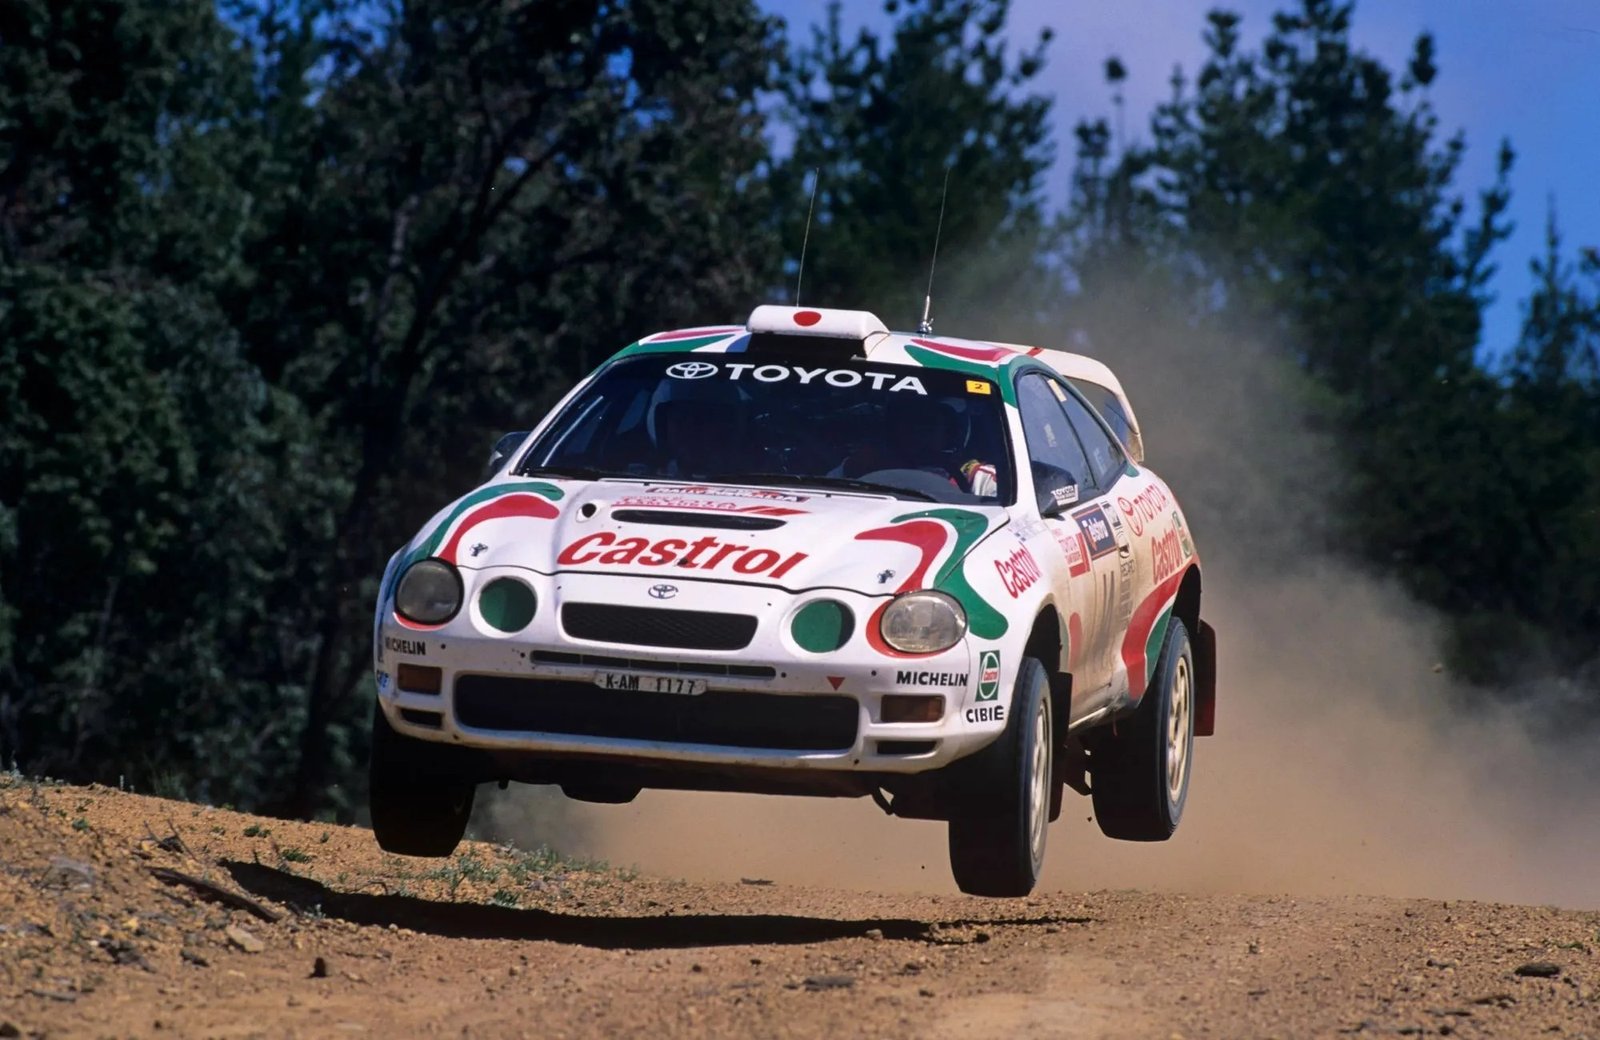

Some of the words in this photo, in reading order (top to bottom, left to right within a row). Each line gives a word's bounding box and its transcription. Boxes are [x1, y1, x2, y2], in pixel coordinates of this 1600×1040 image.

[724, 362, 928, 396] TOYOTA
[557, 532, 809, 579] Castrol
[993, 541, 1041, 599] Castrol
[1151, 522, 1182, 584] Castrol
[896, 670, 969, 687] MICHELIN
